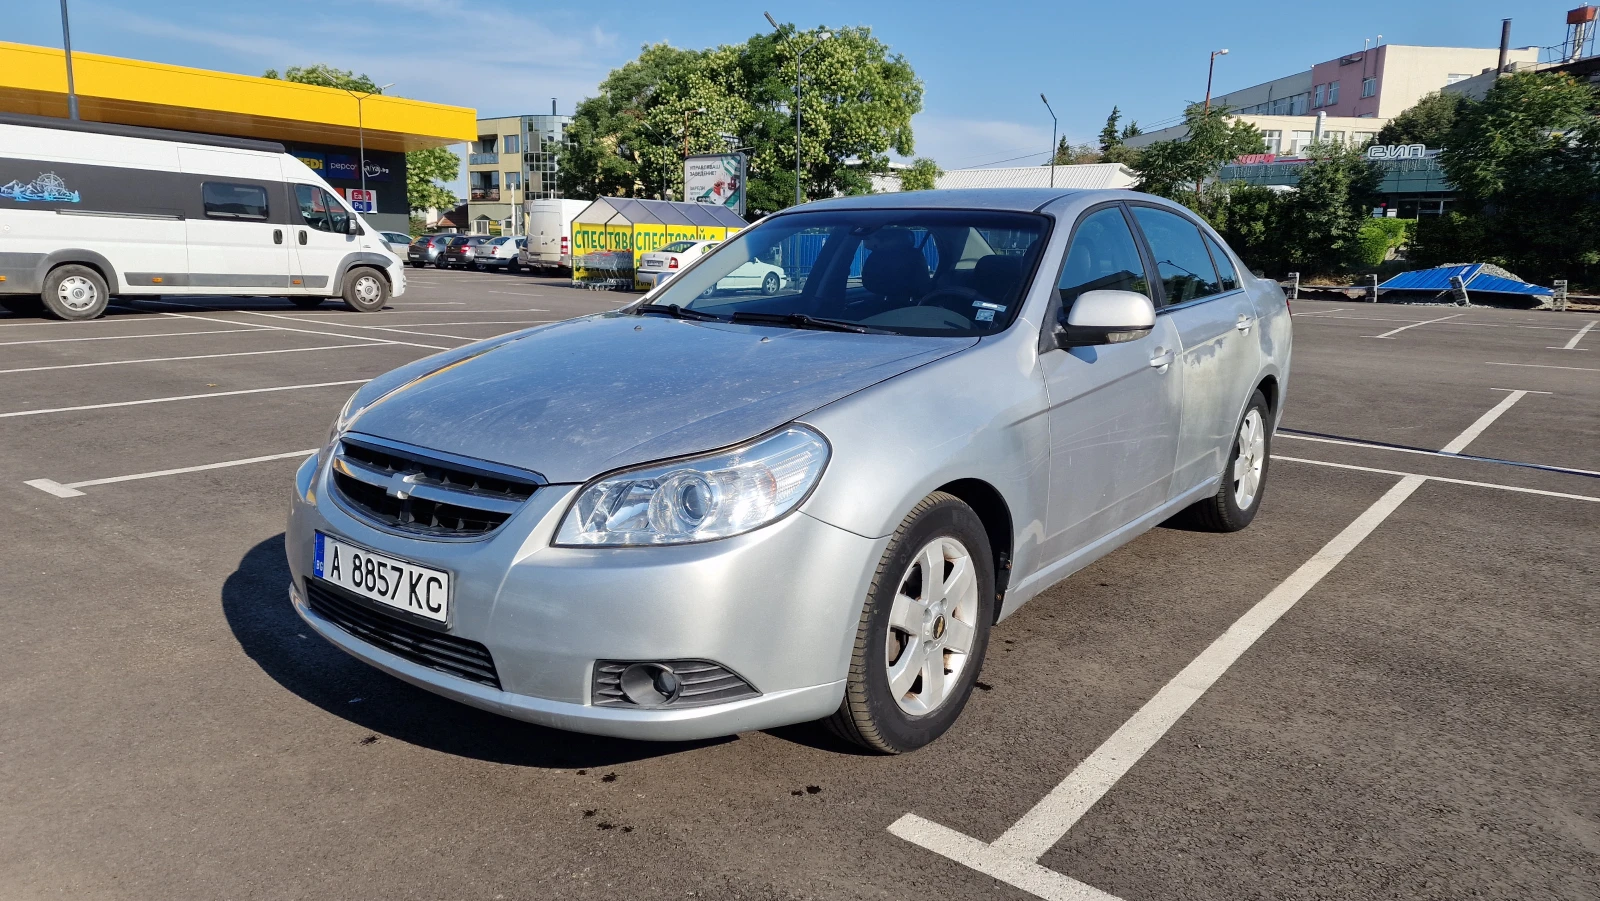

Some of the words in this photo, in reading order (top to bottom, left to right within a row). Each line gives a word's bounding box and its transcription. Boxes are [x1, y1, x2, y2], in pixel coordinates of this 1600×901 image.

[330, 162, 356, 170] pepco
[353, 192, 370, 201] Eay
[331, 545, 342, 580] A
[352, 553, 404, 601] 8857
[408, 570, 443, 614] KC
